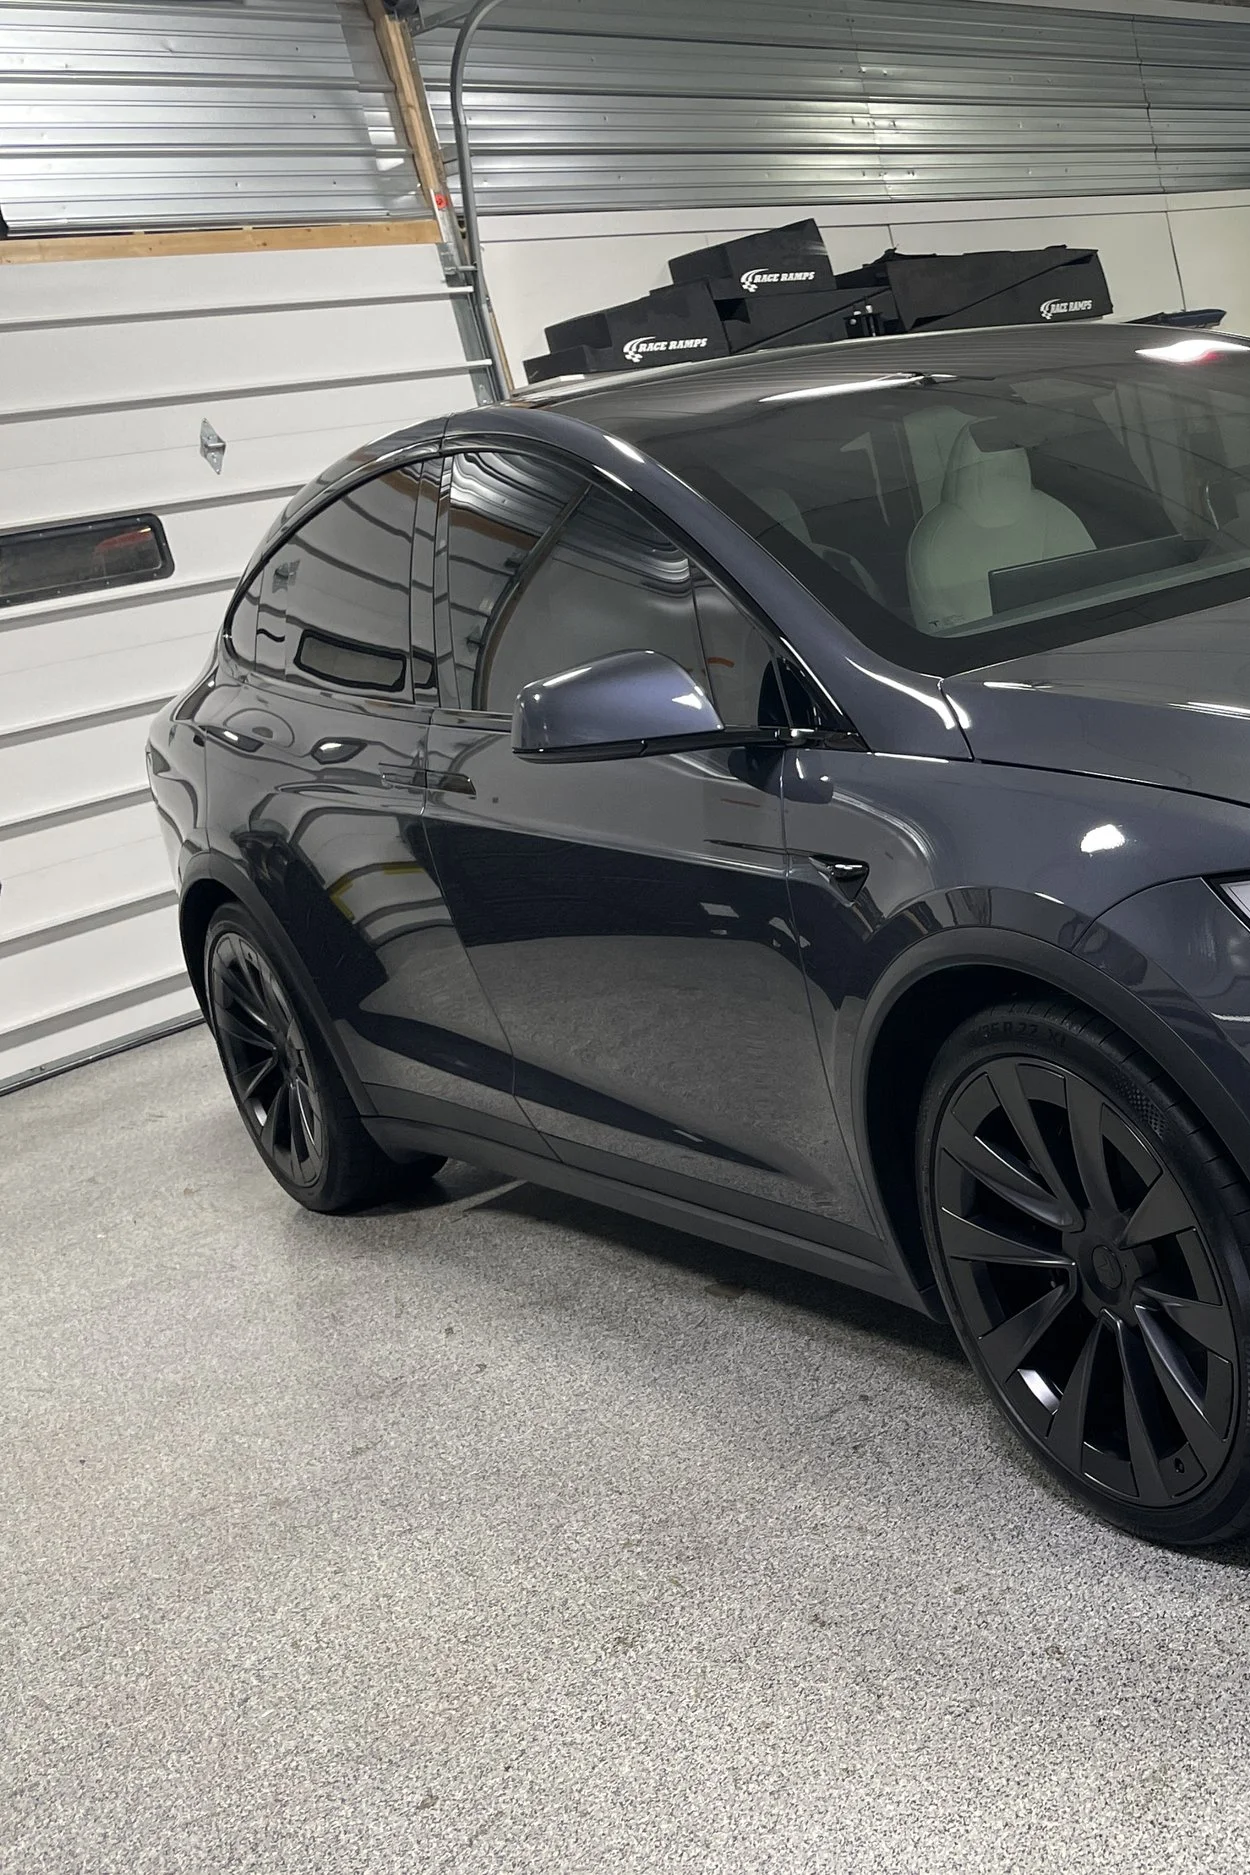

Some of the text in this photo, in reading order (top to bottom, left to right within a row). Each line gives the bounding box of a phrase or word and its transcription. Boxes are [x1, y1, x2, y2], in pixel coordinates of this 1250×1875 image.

[753, 271, 815, 284] RACE RAMPS
[1069, 299, 1093, 312] RAMPS
[637, 338, 708, 353] RACE RAMPS
